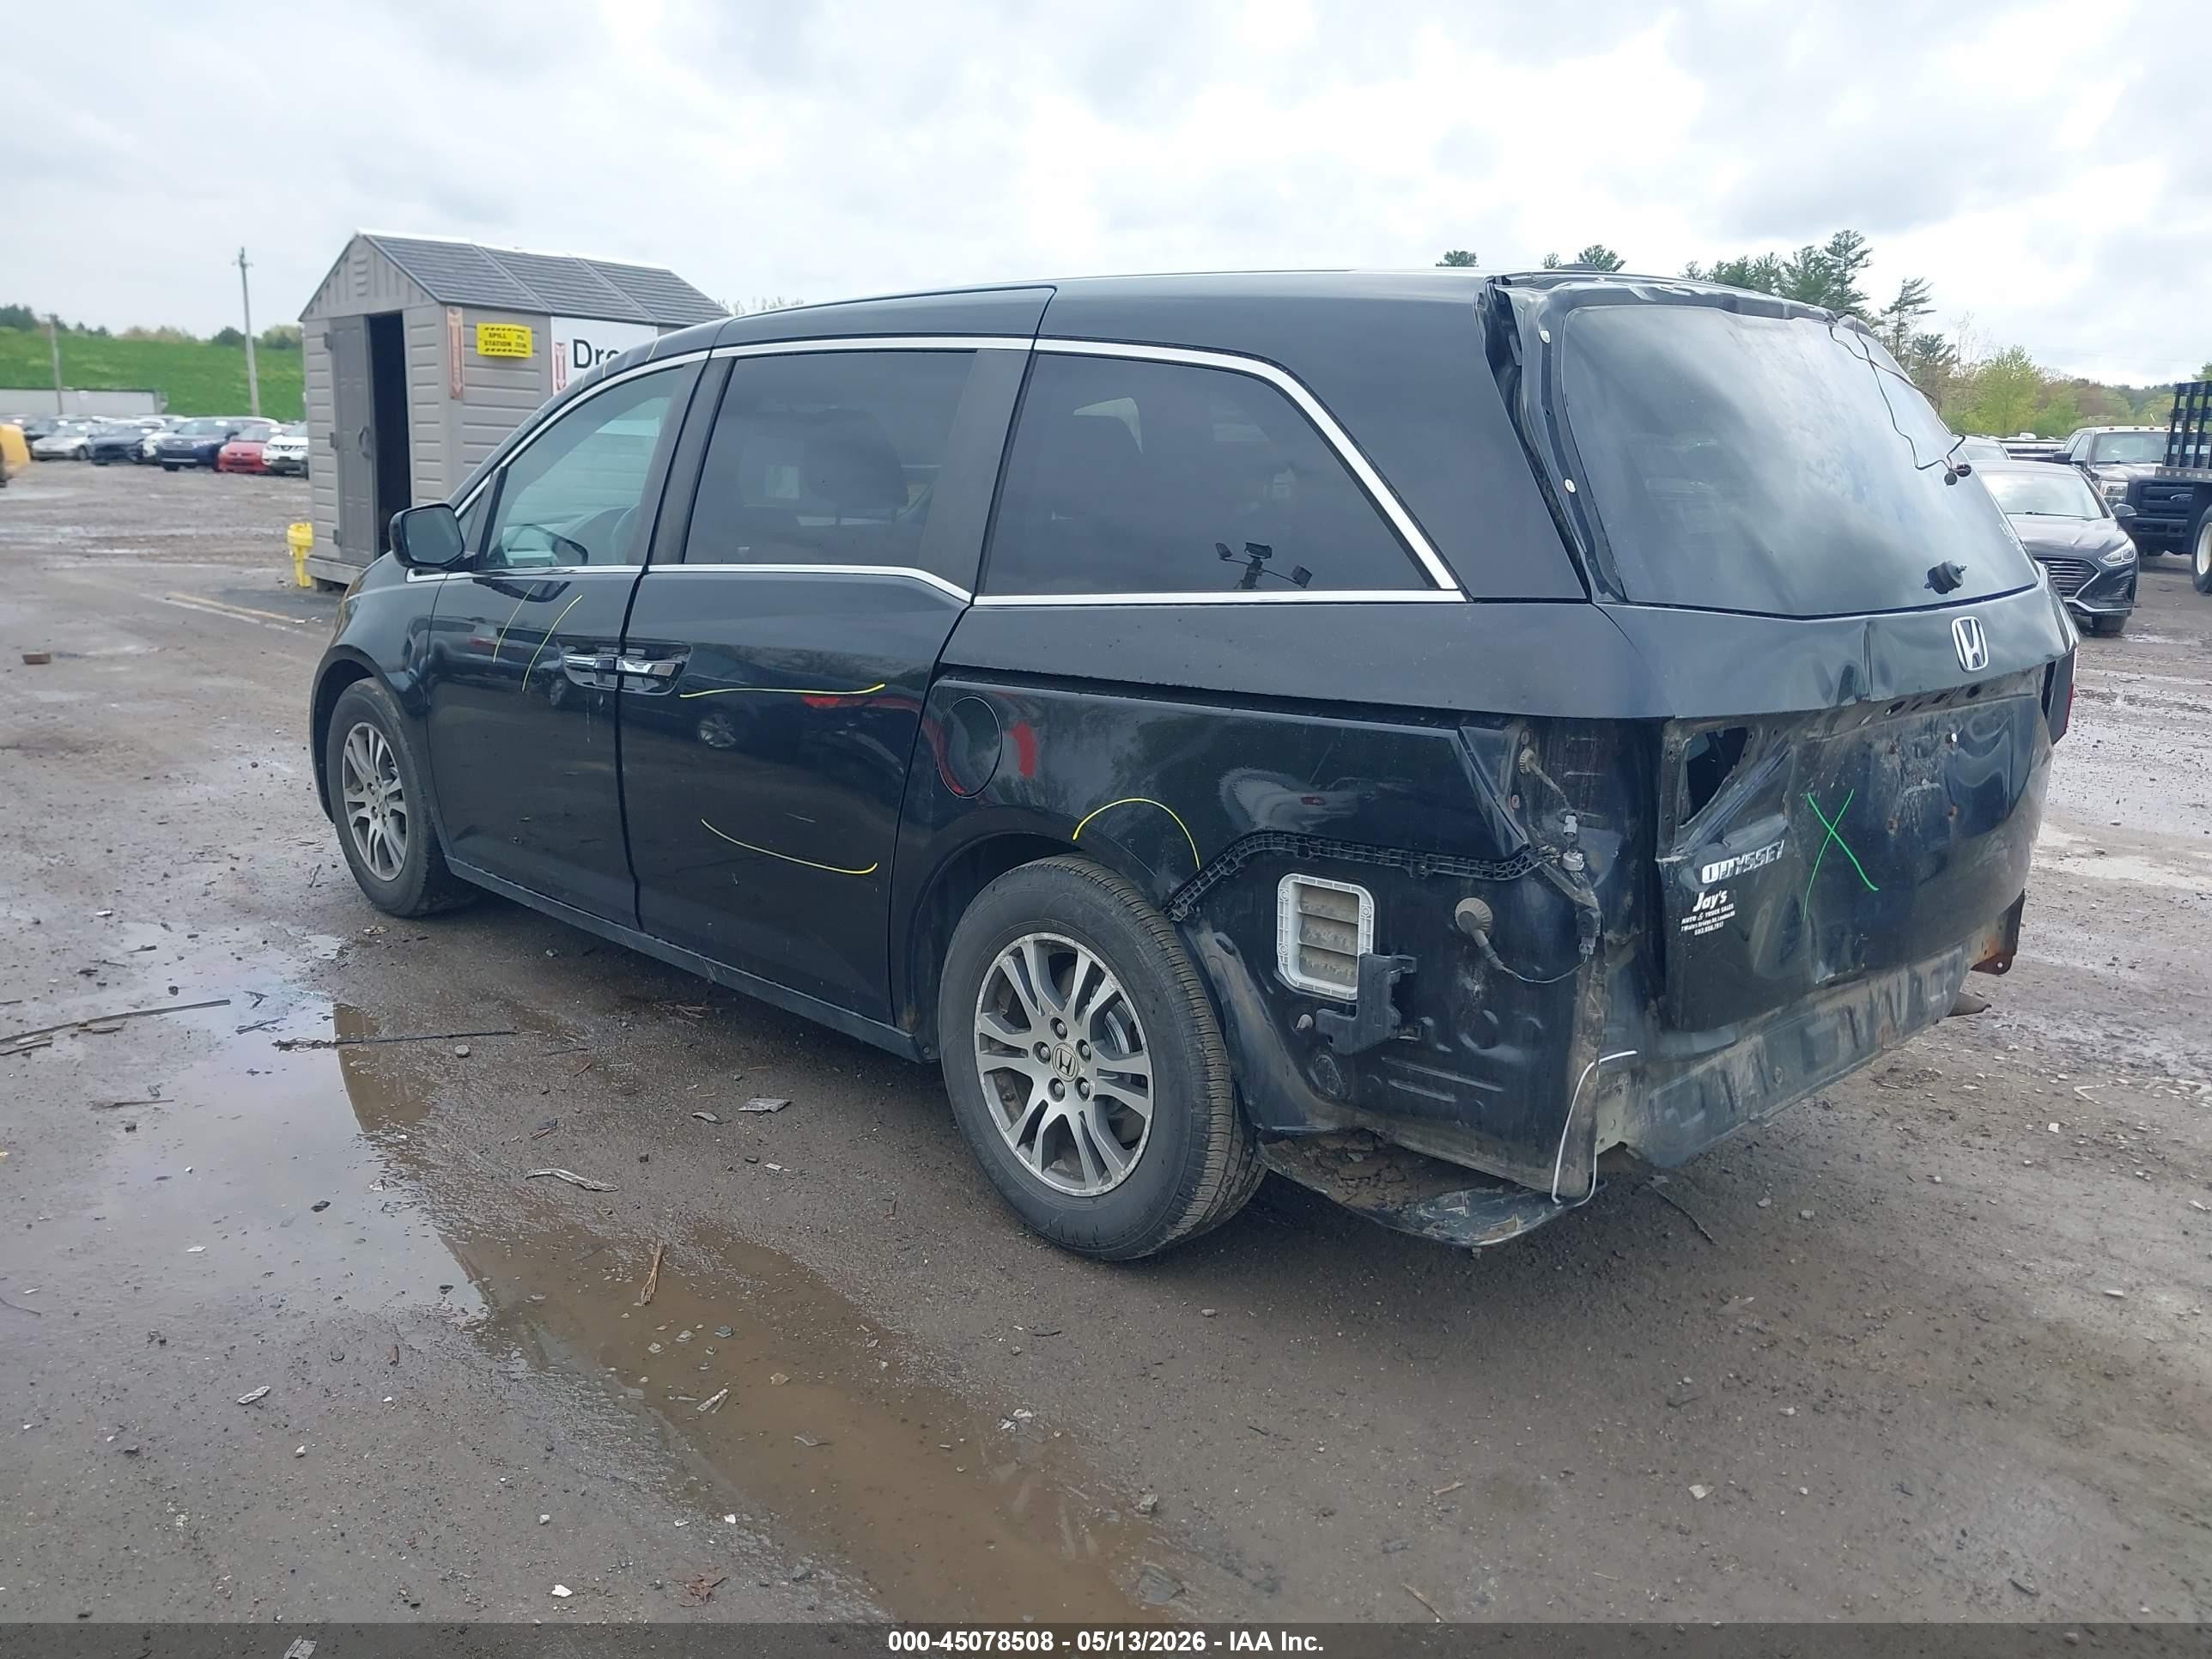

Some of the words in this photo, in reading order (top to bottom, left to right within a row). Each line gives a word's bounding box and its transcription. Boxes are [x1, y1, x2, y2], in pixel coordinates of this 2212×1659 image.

[1701, 838, 1785, 884] ODYSSEY
[1692, 890, 1728, 912] Jay's
[1680, 915, 1697, 925] AUTO
[1697, 912, 1705, 921] &
[1705, 908, 1720, 918] TRUCK
[1720, 902, 1735, 914] SALES
